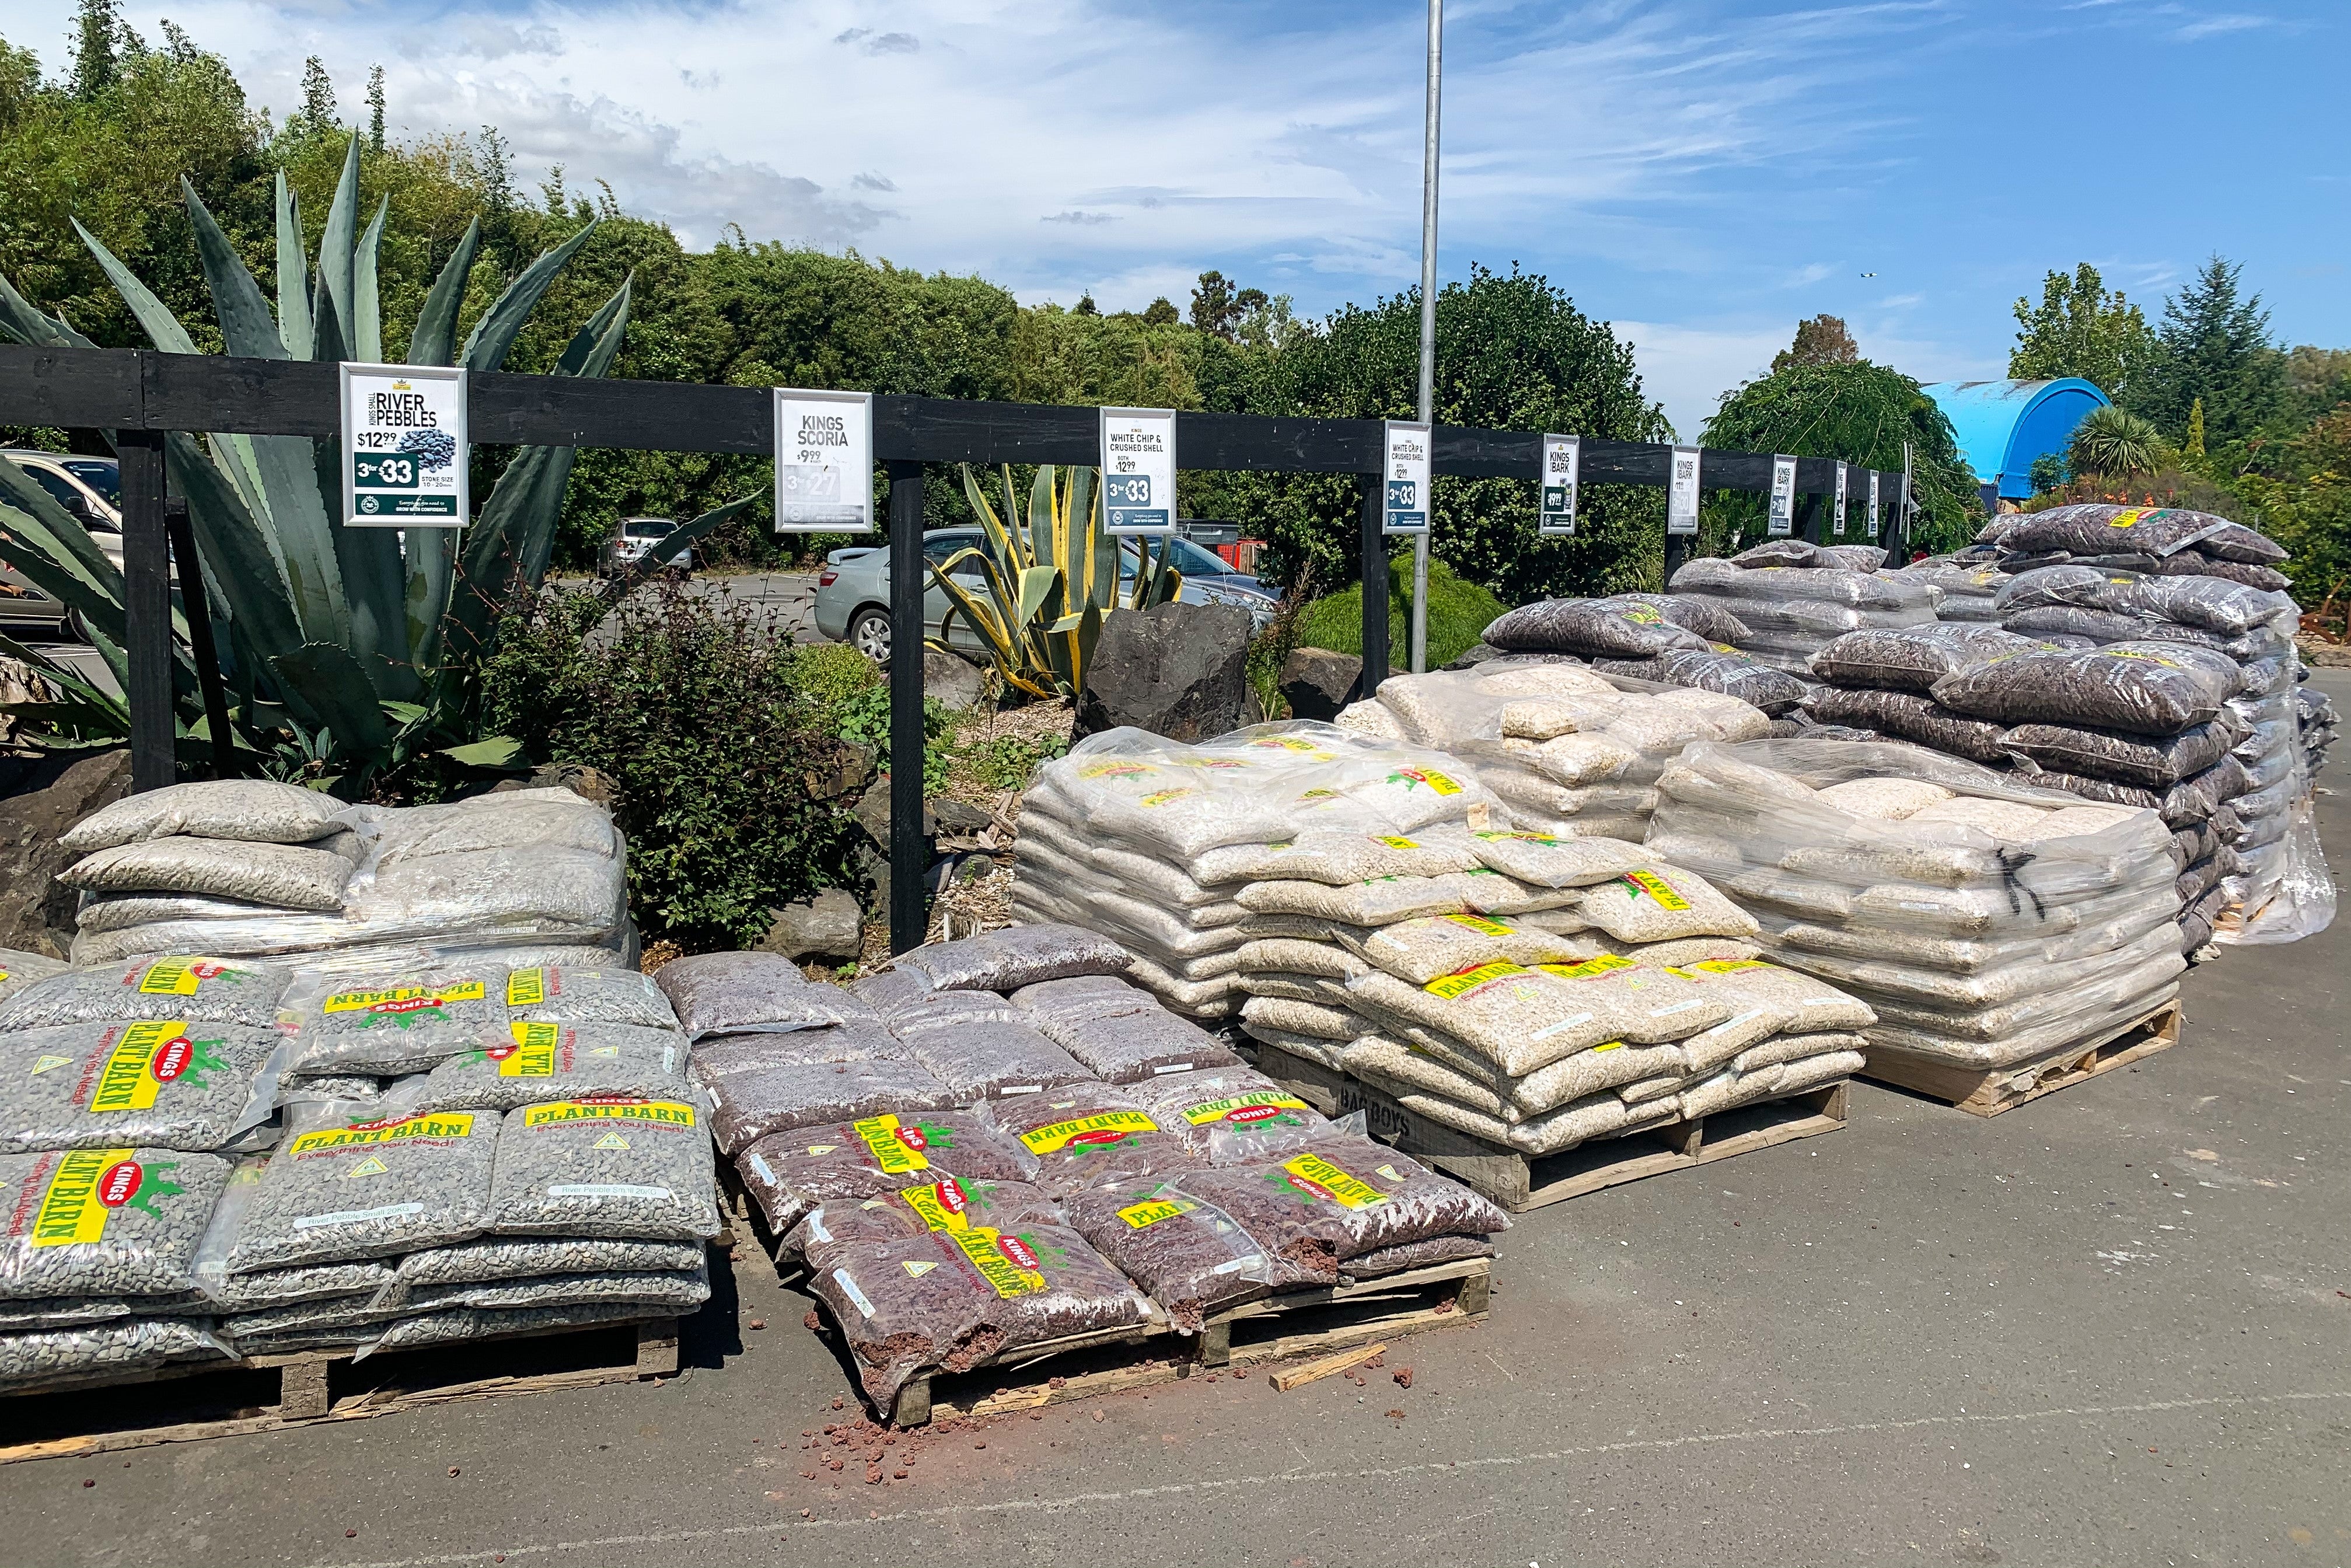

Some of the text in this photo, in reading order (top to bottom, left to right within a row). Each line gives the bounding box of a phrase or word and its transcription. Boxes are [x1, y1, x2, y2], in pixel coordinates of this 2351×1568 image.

[376, 393, 424, 411] RIVER
[377, 410, 436, 427] PEBBLES
[803, 415, 843, 431] KINGS
[798, 430, 848, 446] SCORIA
[1110, 434, 1161, 443] WHITE CHIP &
[1110, 443, 1164, 452] CRUSHED SHELL
[1392, 444, 1407, 452] WHITE
[1550, 451, 1569, 462] KINGS
[1677, 460, 1693, 470] KINGS
[358, 463, 369, 477] 3
[379, 459, 412, 483] $33
[1552, 462, 1569, 473] BARK
[1679, 470, 1692, 479] BARK
[1778, 467, 1790, 476] KINGS
[788, 475, 797, 490] 3
[1109, 483, 1117, 497] 3
[1125, 480, 1148, 502] $33
[1389, 488, 1395, 500] 3
[1437, 971, 1487, 996] PLANT
[334, 990, 398, 1005] BARN
[520, 1024, 554, 1074] PLA ARN
[83, 1057, 100, 1075] You
[96, 1022, 166, 1105] PLANT BARN
[159, 1042, 187, 1078] KINGS
[71, 1077, 92, 1105] Need!
[532, 1106, 687, 1123] PLANT BARN
[1084, 1112, 1147, 1129] PLANT
[1230, 1107, 1276, 1121] KINGS
[1371, 1101, 1410, 1136] BOYS
[537, 1120, 610, 1133] Everything
[645, 1123, 685, 1133] Need!
[297, 1122, 464, 1151] PLANT BARN
[297, 1138, 454, 1161] Everything You Need!
[107, 1166, 135, 1201] KINGS
[584, 1186, 610, 1194] Pebble
[1291, 1178, 1331, 1199] KINGS
[941, 1179, 965, 1211] KINGS
[37, 1187, 90, 1238] BARN
[308, 1205, 409, 1225] River Pebble Small 20KG
[1003, 1238, 1036, 1267] KINGS
